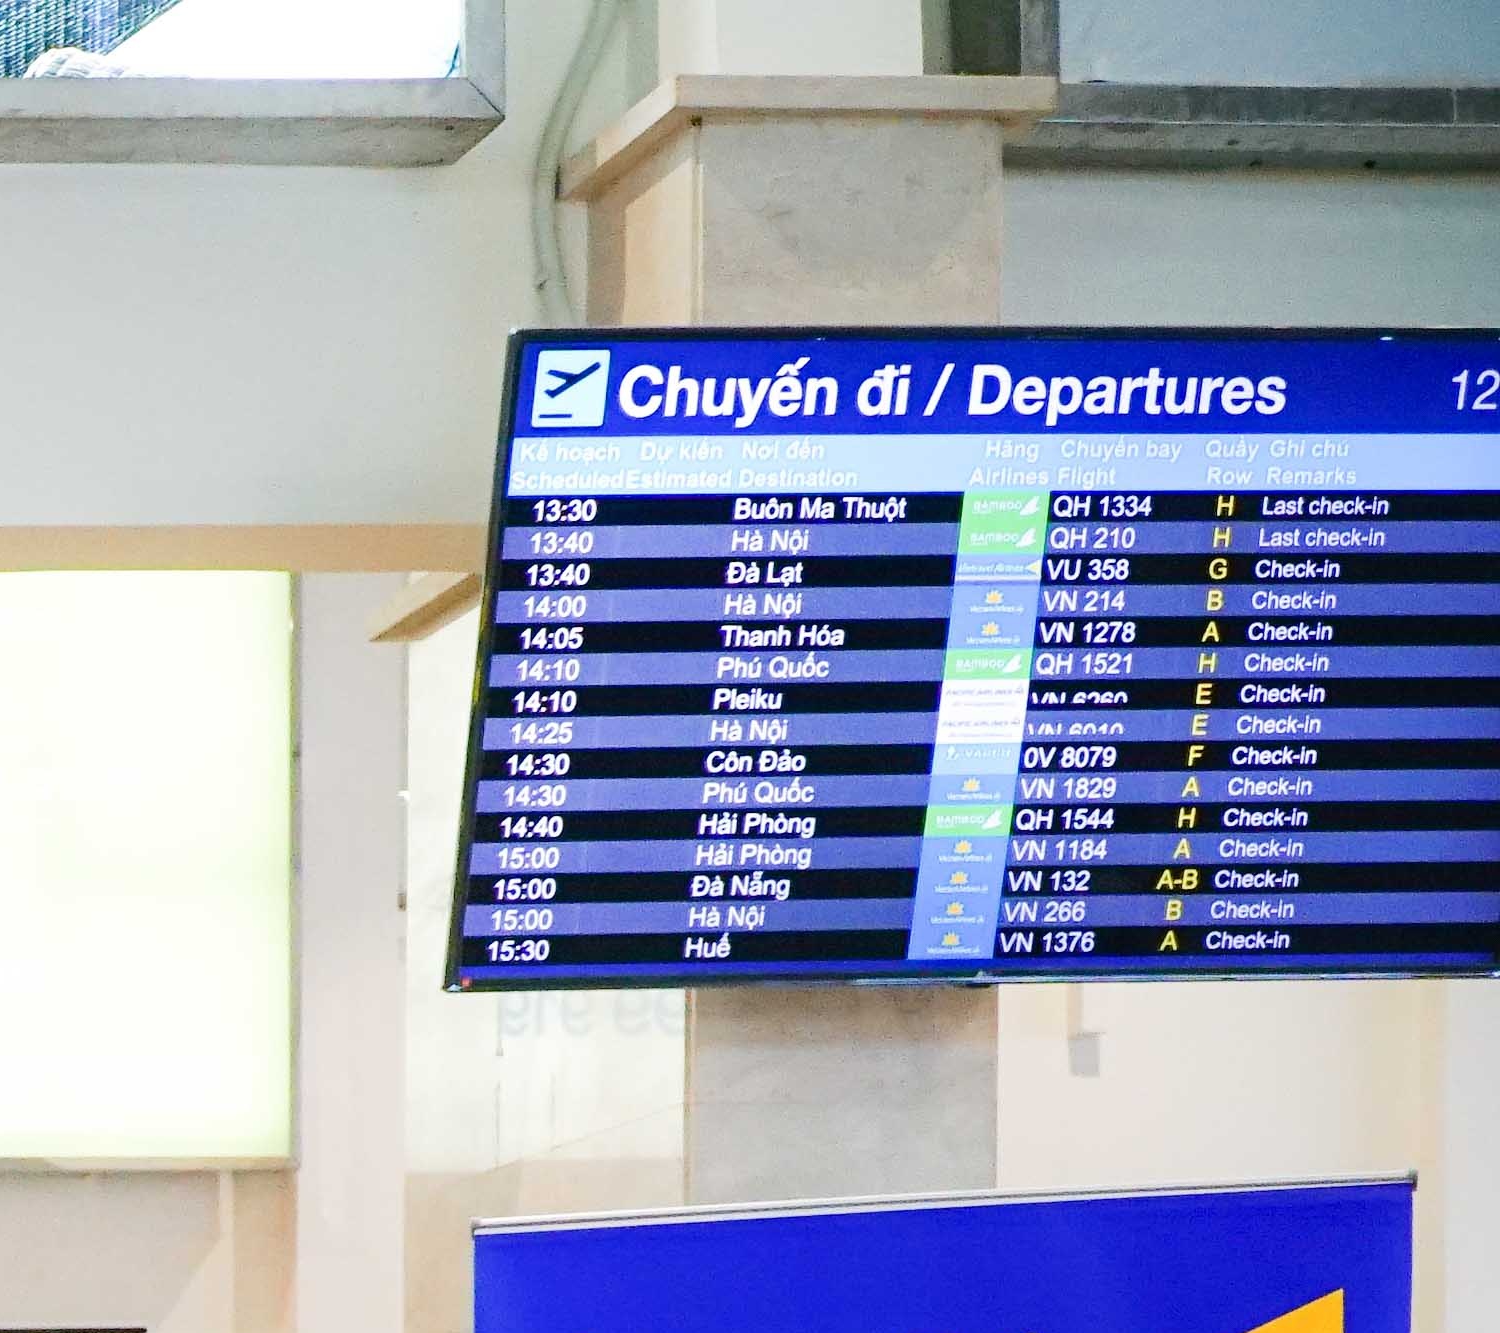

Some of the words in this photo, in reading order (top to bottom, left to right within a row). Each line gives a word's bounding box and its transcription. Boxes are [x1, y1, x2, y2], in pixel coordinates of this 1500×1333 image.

[618, 357, 841, 430] Chuyến
[856, 363, 910, 416] đi
[923, 363, 956, 417] /
[967, 363, 1288, 427] Departures
[526, 562, 591, 588] 13:40
[727, 562, 763, 588] Đà
[767, 561, 804, 588] Lạt
[1046, 559, 1083, 582] VU
[1087, 558, 1130, 581] 358
[1208, 558, 1229, 580] G
[1254, 557, 1341, 580] Check-in
[493, 876, 558, 901] 15:00
[690, 874, 727, 899] Đà
[731, 869, 791, 903] Nẵng
[1008, 871, 1044, 893] VN
[1048, 870, 1091, 893] 132
[1155, 869, 1199, 891] A-B
[1214, 868, 1300, 890] Check-in
[487, 937, 550, 962] 15:30
[684, 935, 731, 959] Huế
[999, 931, 1035, 954] VN
[1041, 931, 1096, 954] 1376
[1158, 931, 1179, 952] A
[1205, 930, 1291, 952] Check-in
